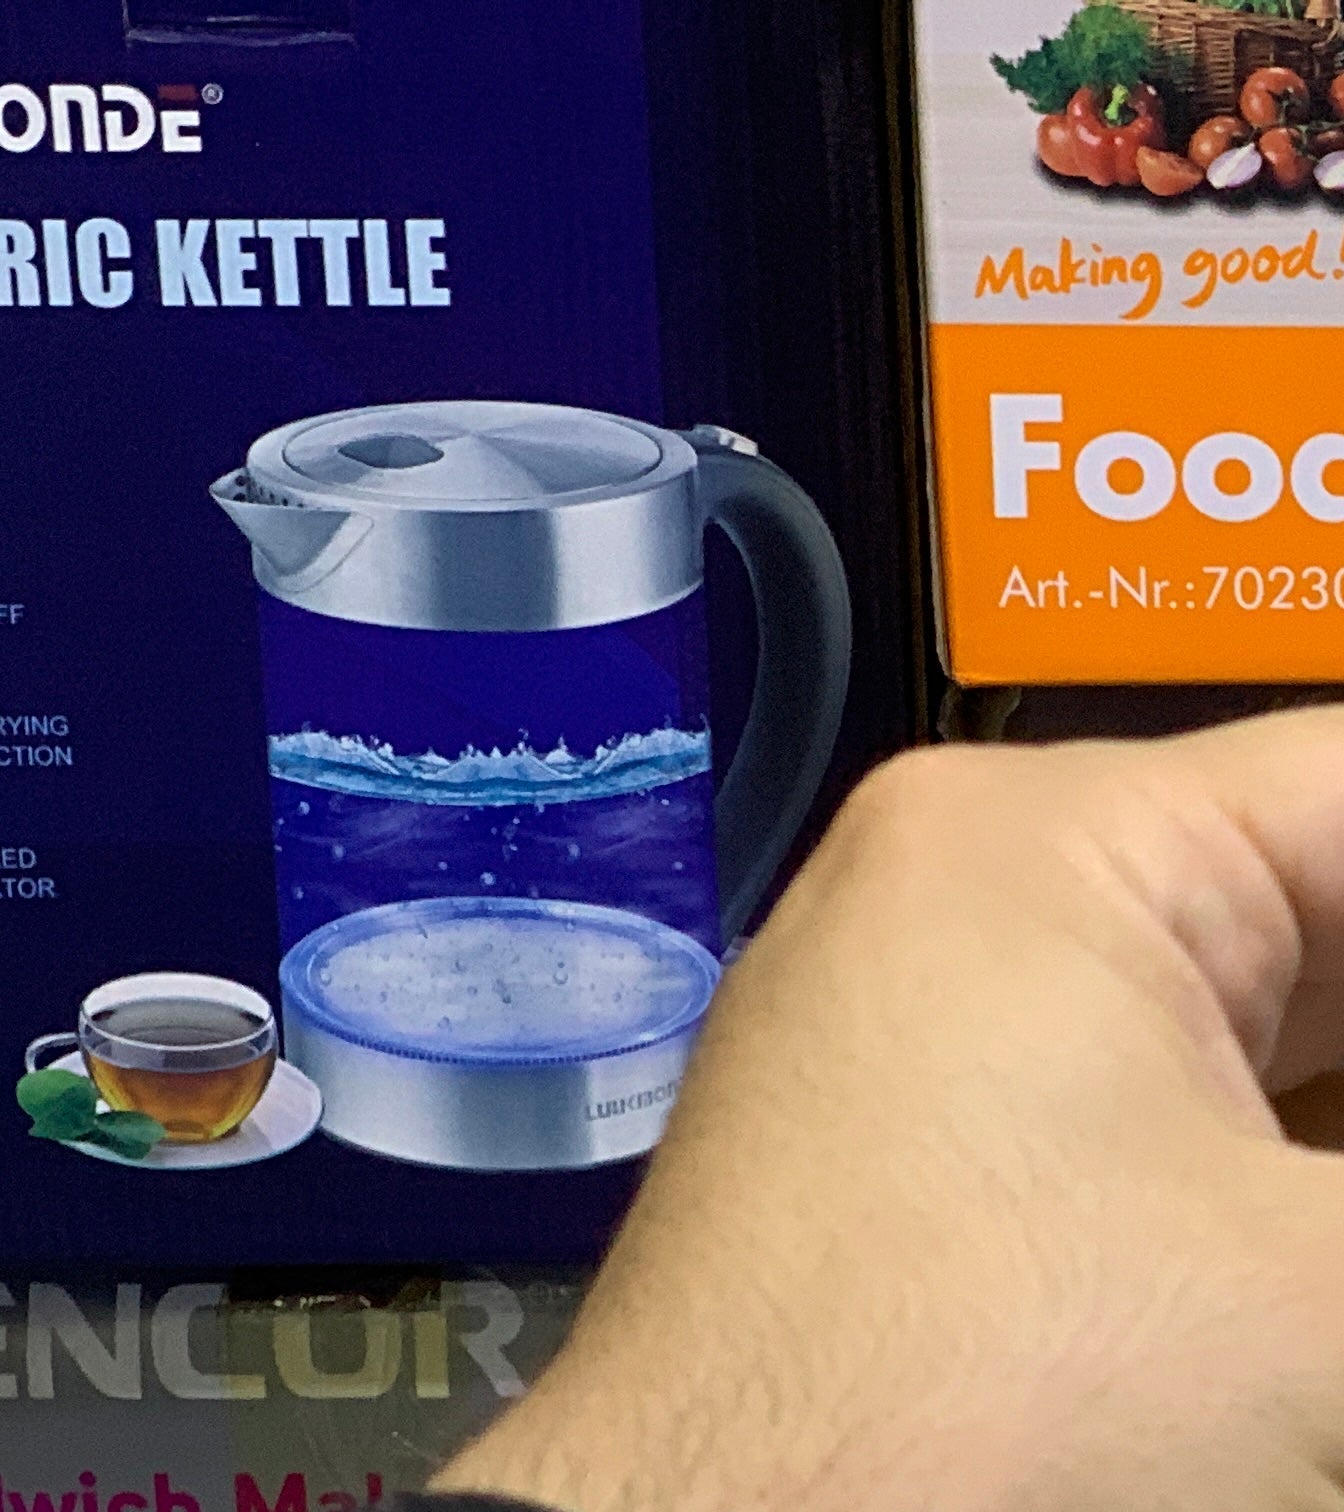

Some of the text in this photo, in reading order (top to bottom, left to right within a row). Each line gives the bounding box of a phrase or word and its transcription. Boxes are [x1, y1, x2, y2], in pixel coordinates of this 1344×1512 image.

[0, 218, 451, 308] RIC KETTLE
[975, 238, 1163, 320] Making
[0, 1281, 530, 1400] NCOR
